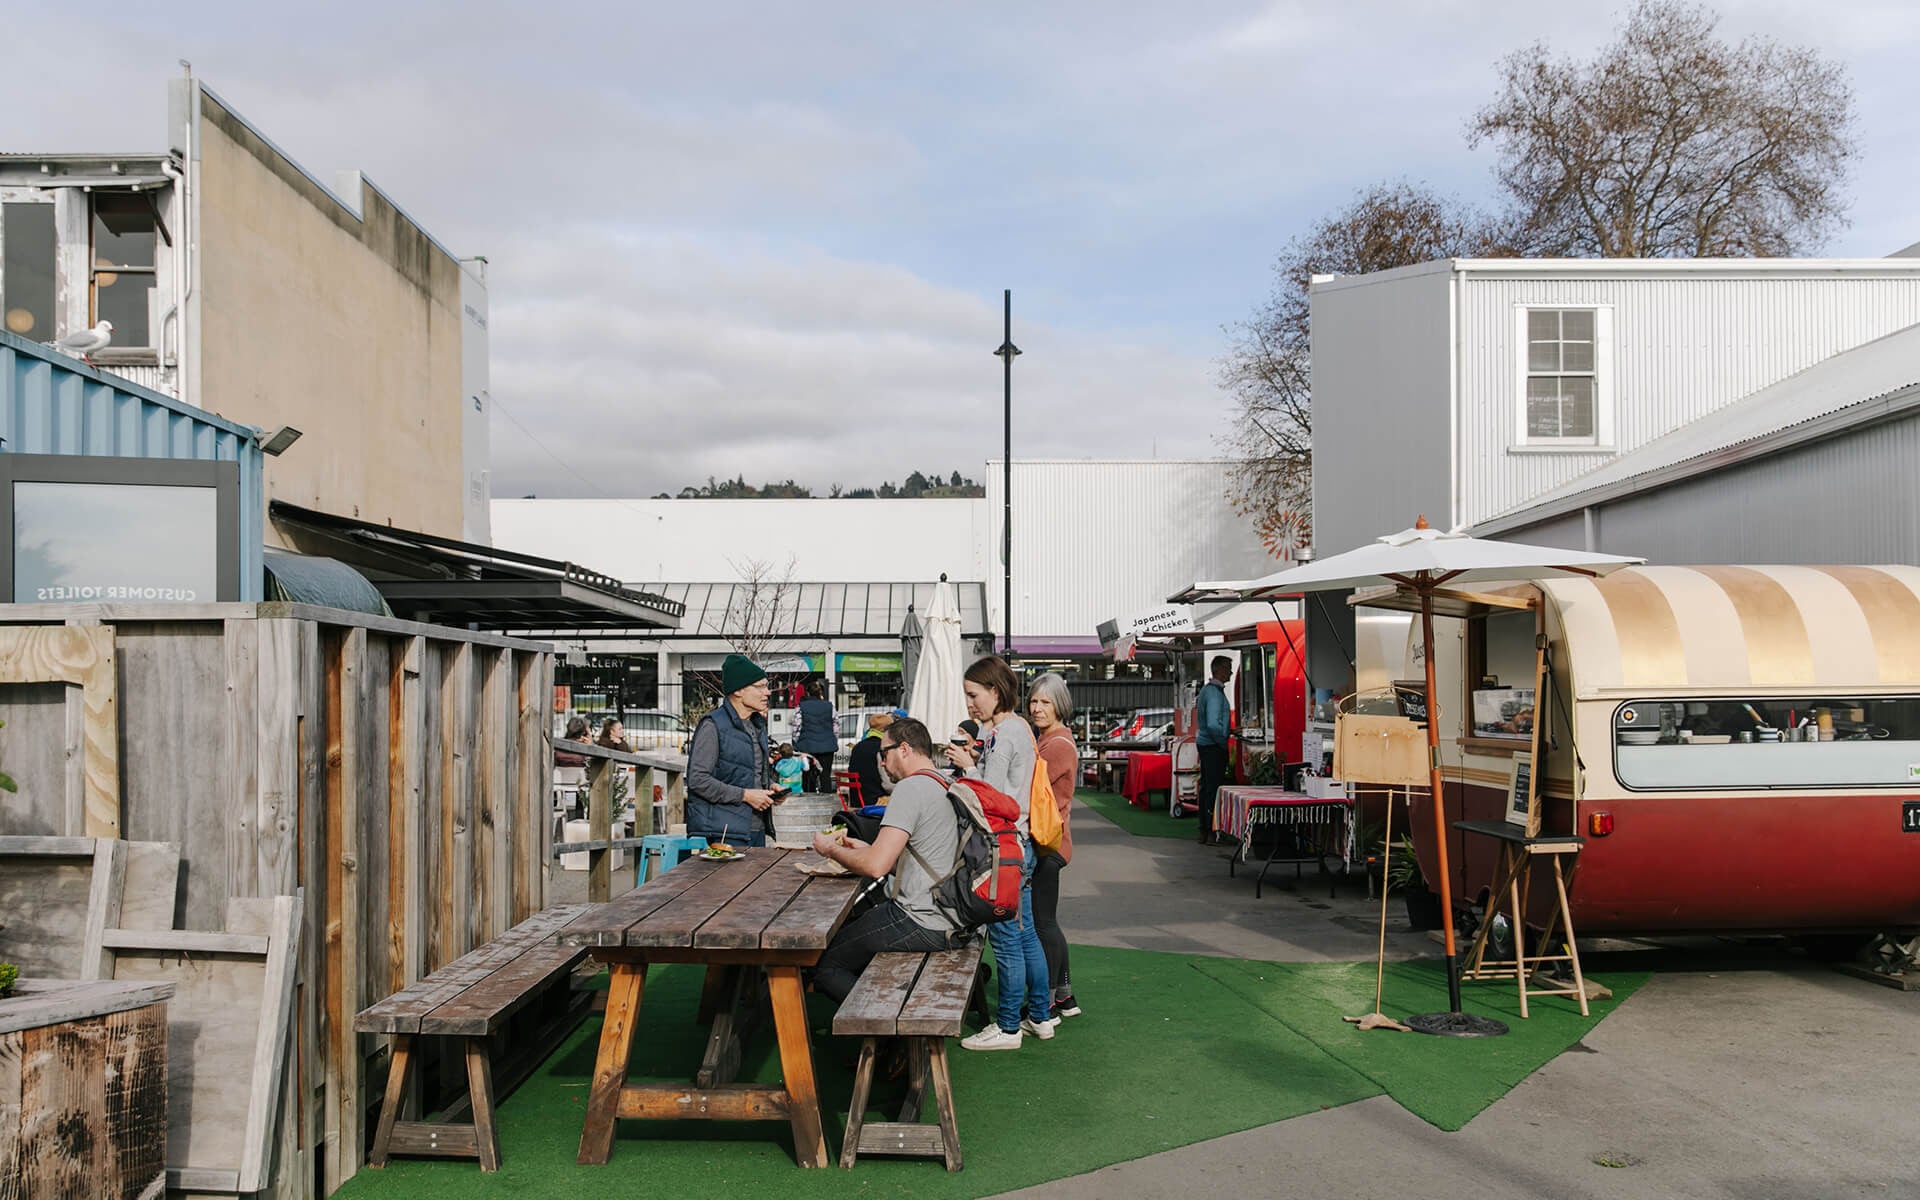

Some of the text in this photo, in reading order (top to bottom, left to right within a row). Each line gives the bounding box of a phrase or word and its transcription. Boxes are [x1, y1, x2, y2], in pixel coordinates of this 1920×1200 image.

[1132, 609, 1177, 627] Japanese
[1151, 618, 1189, 633] Chicken
[554, 658, 625, 668] RT ALLERY
